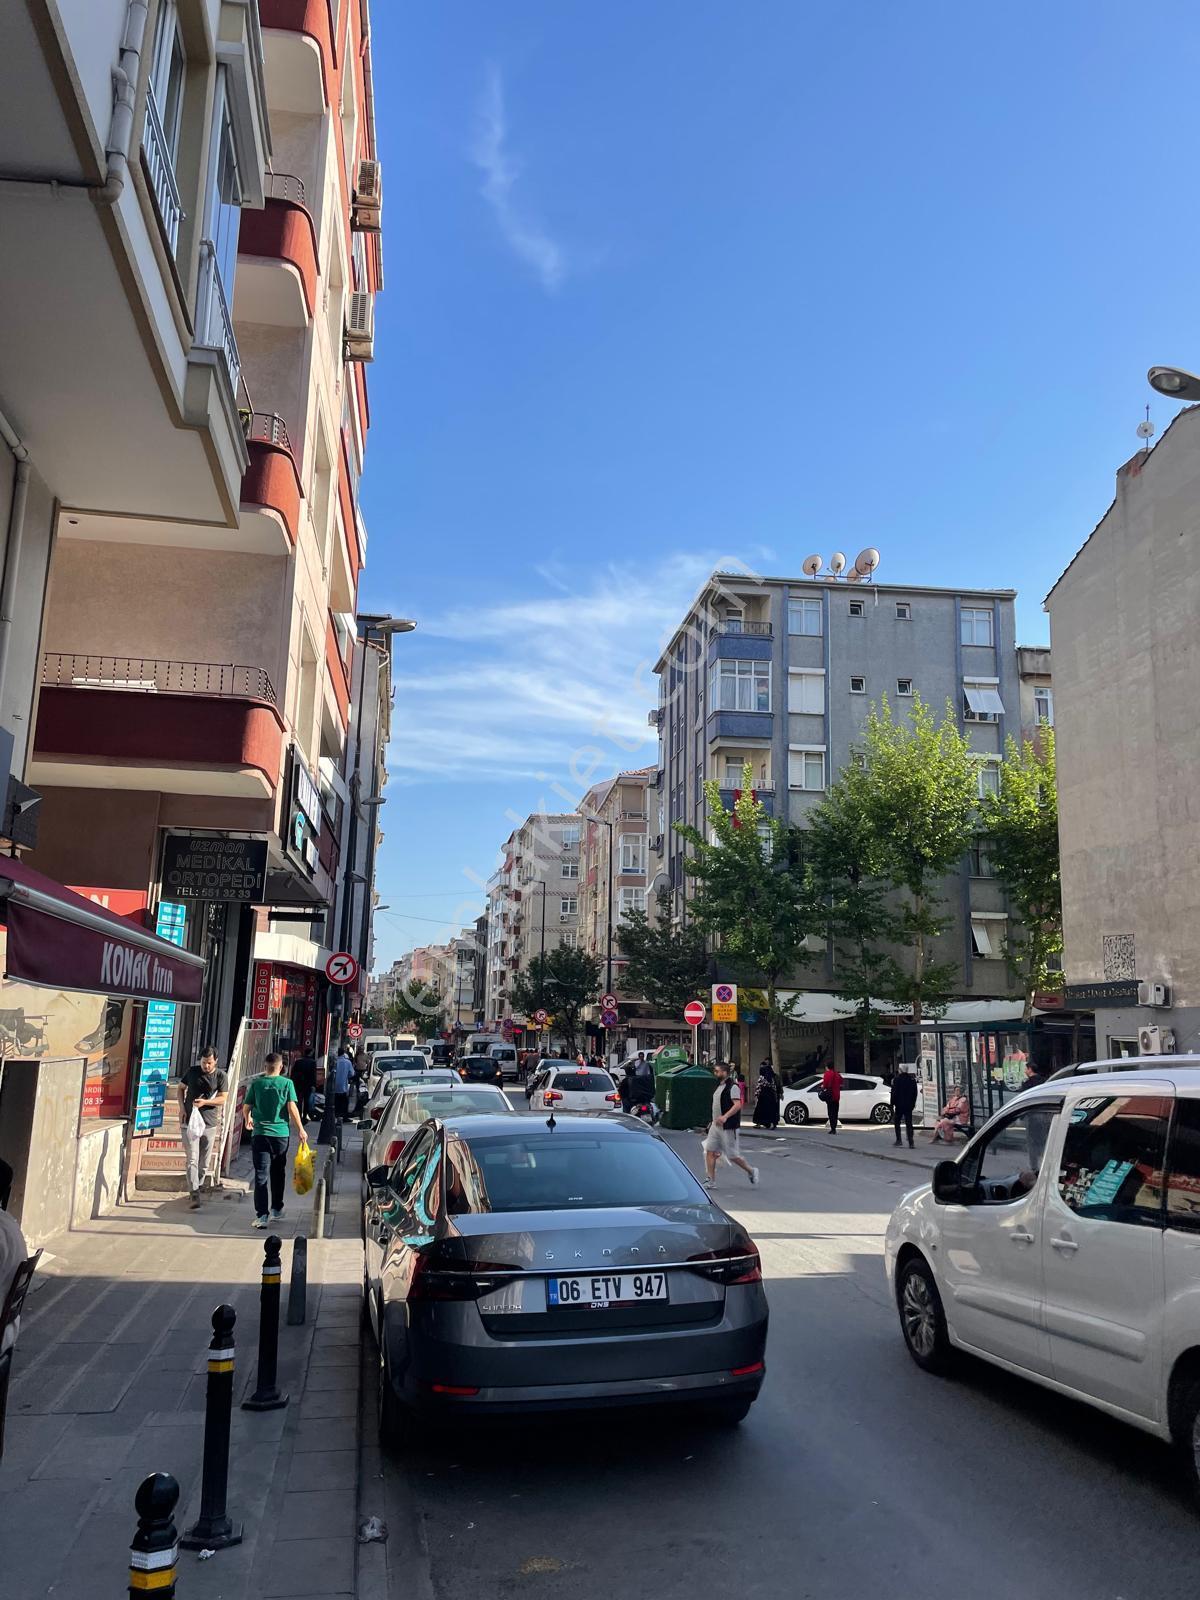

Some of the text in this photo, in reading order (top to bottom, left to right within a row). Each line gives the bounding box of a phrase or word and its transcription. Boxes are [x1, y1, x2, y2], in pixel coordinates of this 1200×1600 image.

[175, 853, 255, 872] MEDİKAL
[167, 870, 262, 889] ORTOPEDİ
[175, 886, 199, 896] TEL:
[100, 941, 150, 992] KONAK
[559, 1280, 581, 1301] 06
[591, 1276, 622, 1300] ETV
[633, 1275, 664, 1297] 947
